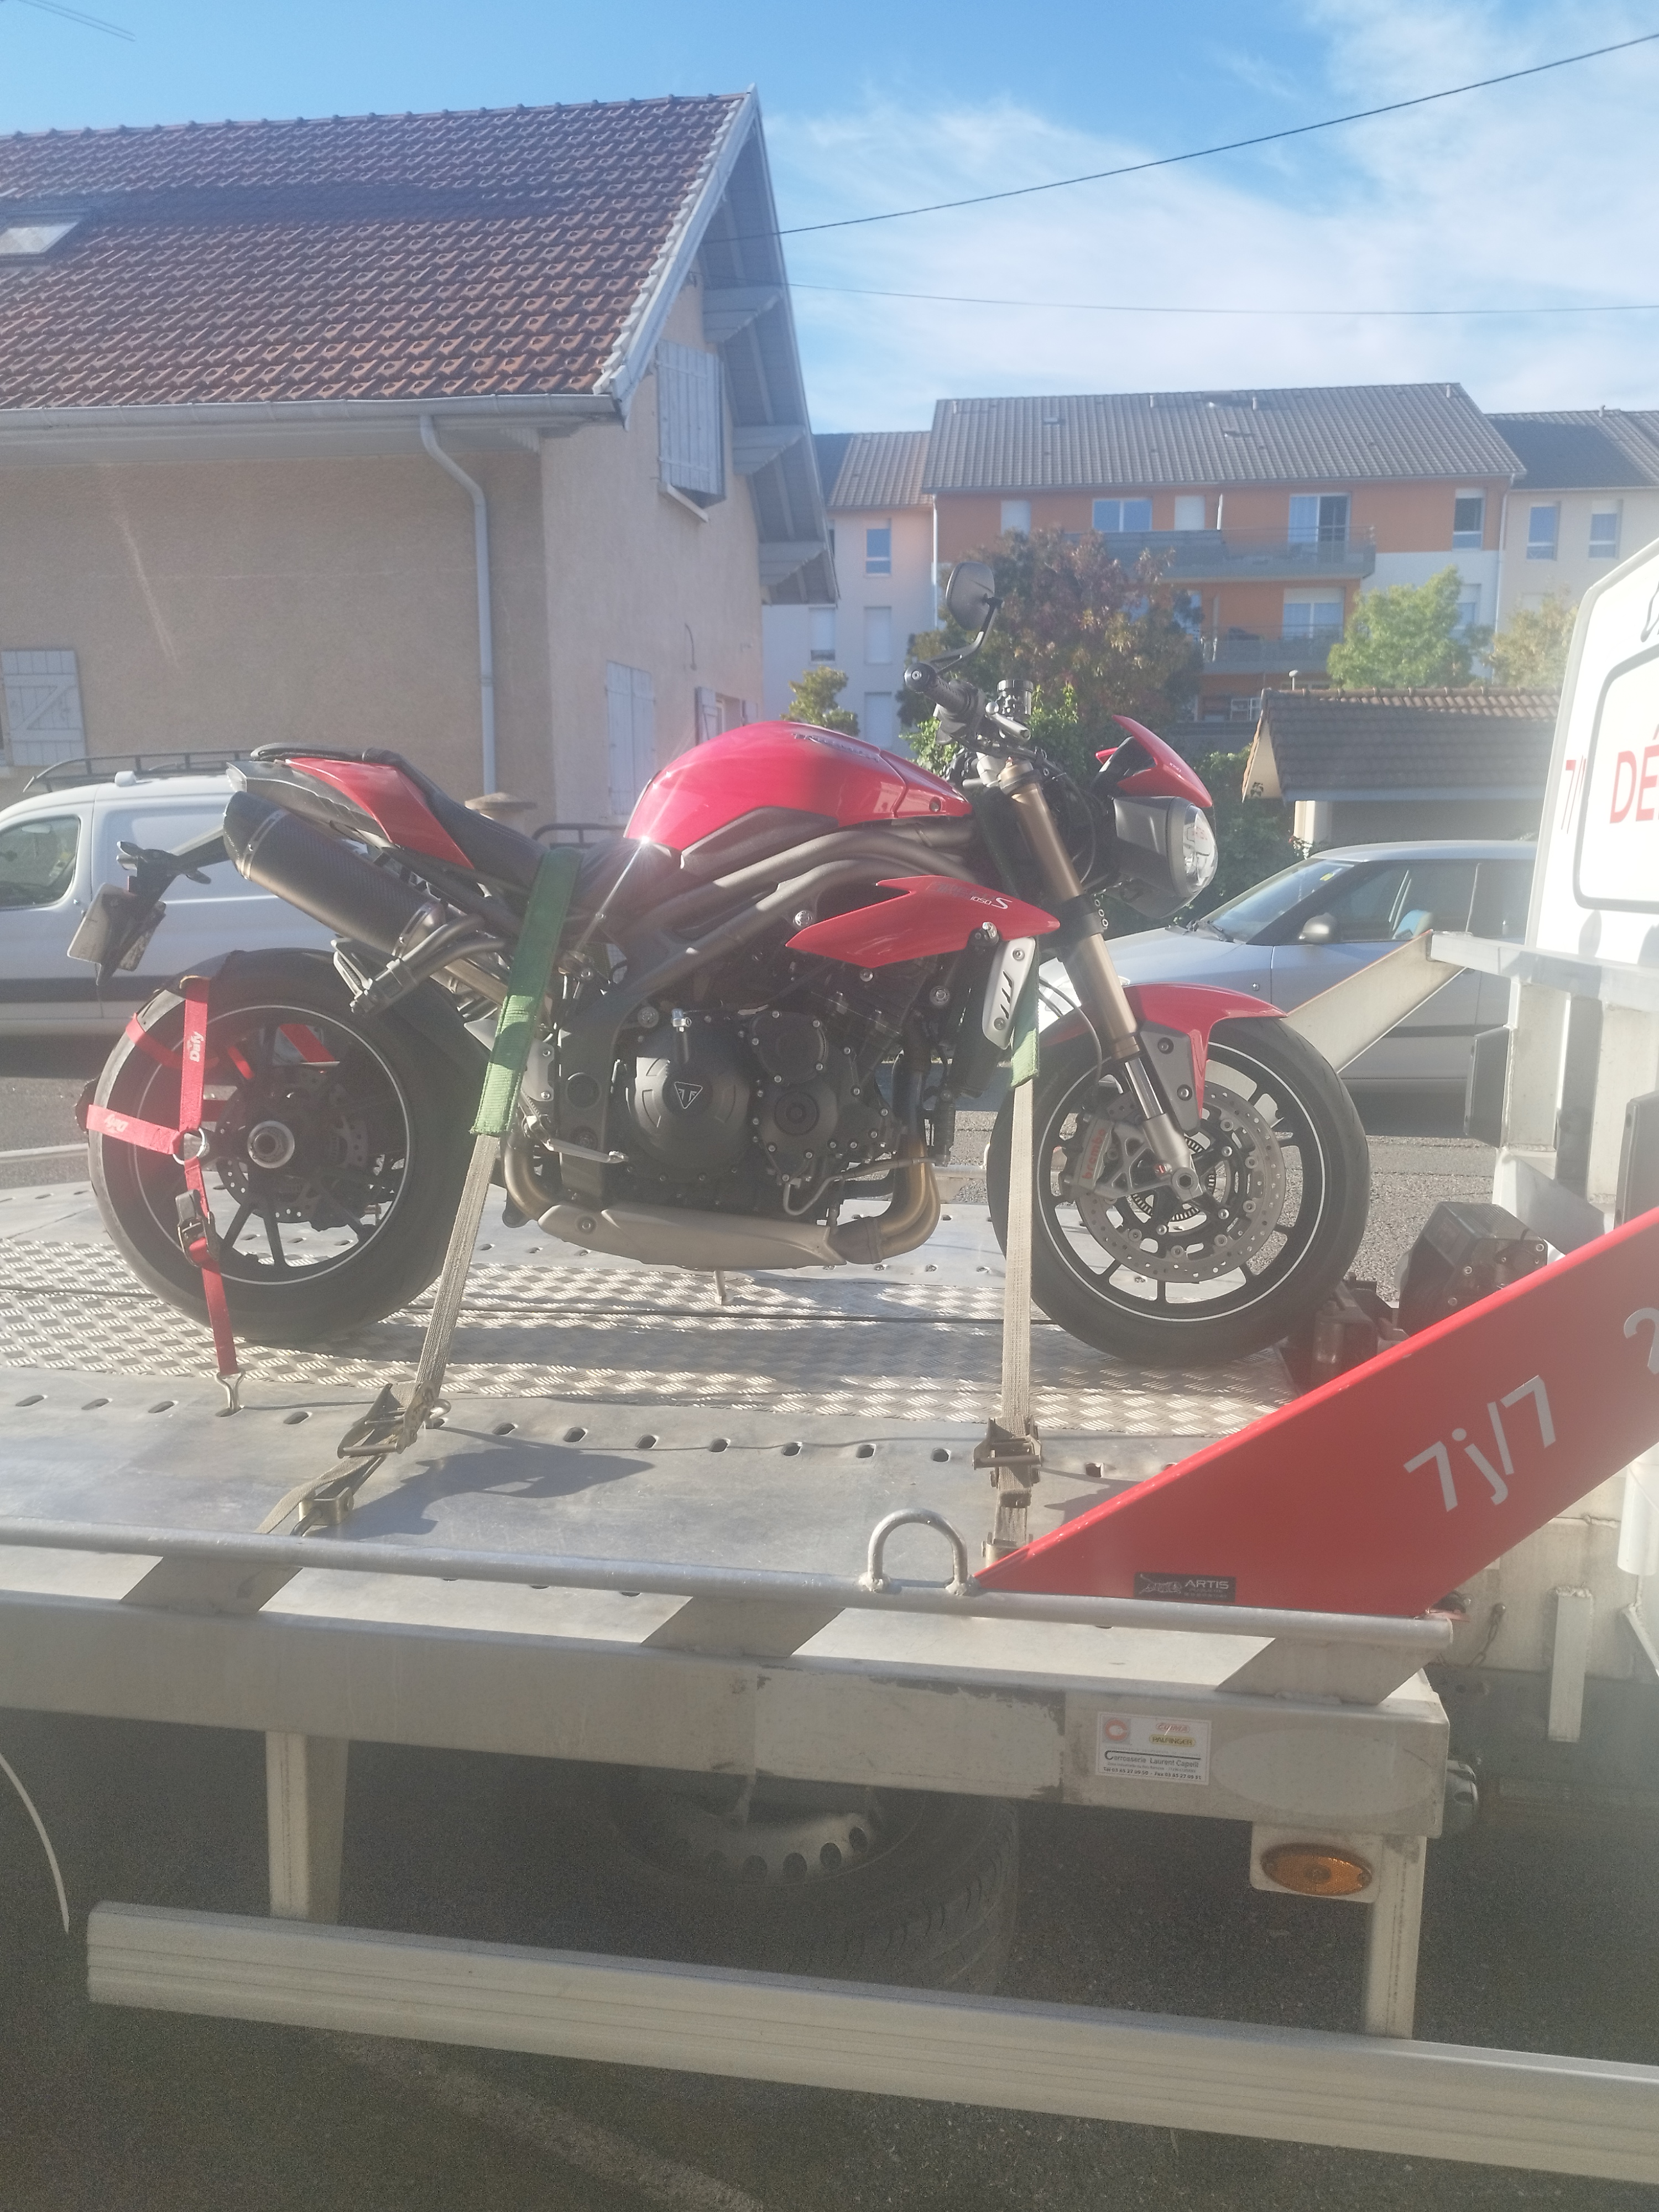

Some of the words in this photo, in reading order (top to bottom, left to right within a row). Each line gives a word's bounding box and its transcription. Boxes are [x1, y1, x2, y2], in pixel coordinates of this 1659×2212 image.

[1610, 724, 1659, 824] DÉ
[970, 895, 992, 906] 1050
[991, 897, 1013, 910] S
[189, 1031, 204, 1062] Dafy
[1082, 1129, 1105, 1178] brembo
[1404, 1374, 1557, 1512] 7j/7
[1185, 1580, 1229, 1589] ARTIS
[1152, 1736, 1192, 1745] PALFINGER
[1104, 1750, 1146, 1763] Carrosserie
[1150, 1757, 1175, 1766] Laurent
[1176, 1760, 1199, 1768] Capelli
